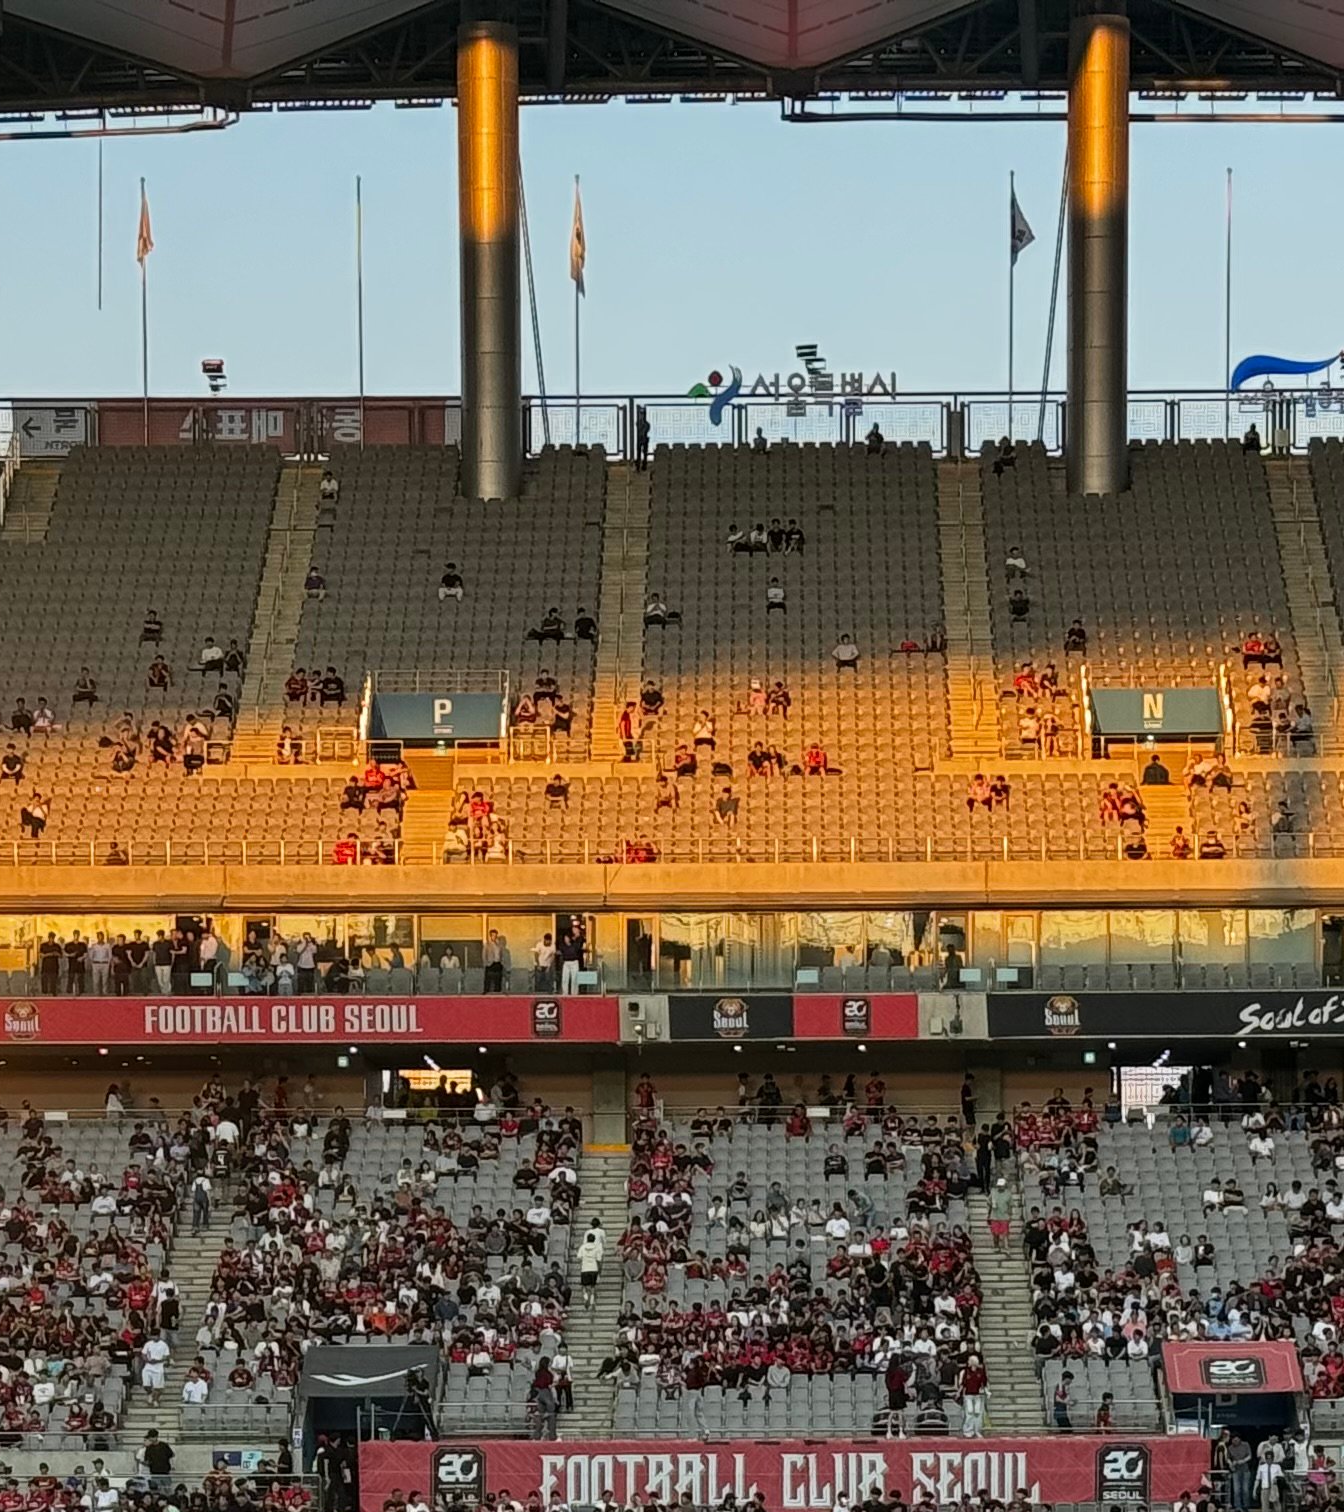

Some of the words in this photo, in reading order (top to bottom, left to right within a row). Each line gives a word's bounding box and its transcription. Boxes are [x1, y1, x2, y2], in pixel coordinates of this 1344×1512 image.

[434, 698, 452, 724] P
[1143, 693, 1163, 718] N
[144, 1005, 266, 1034] FOOTBALL
[271, 1005, 335, 1034] CLUB
[344, 1005, 424, 1034] SEOUL
[1236, 996, 1306, 1036] Soul
[1308, 995, 1339, 1024] of
[539, 1452, 758, 1508] FOOTBALL
[780, 1452, 890, 1508] CLUB
[910, 1452, 1041, 1507] SEOUL
